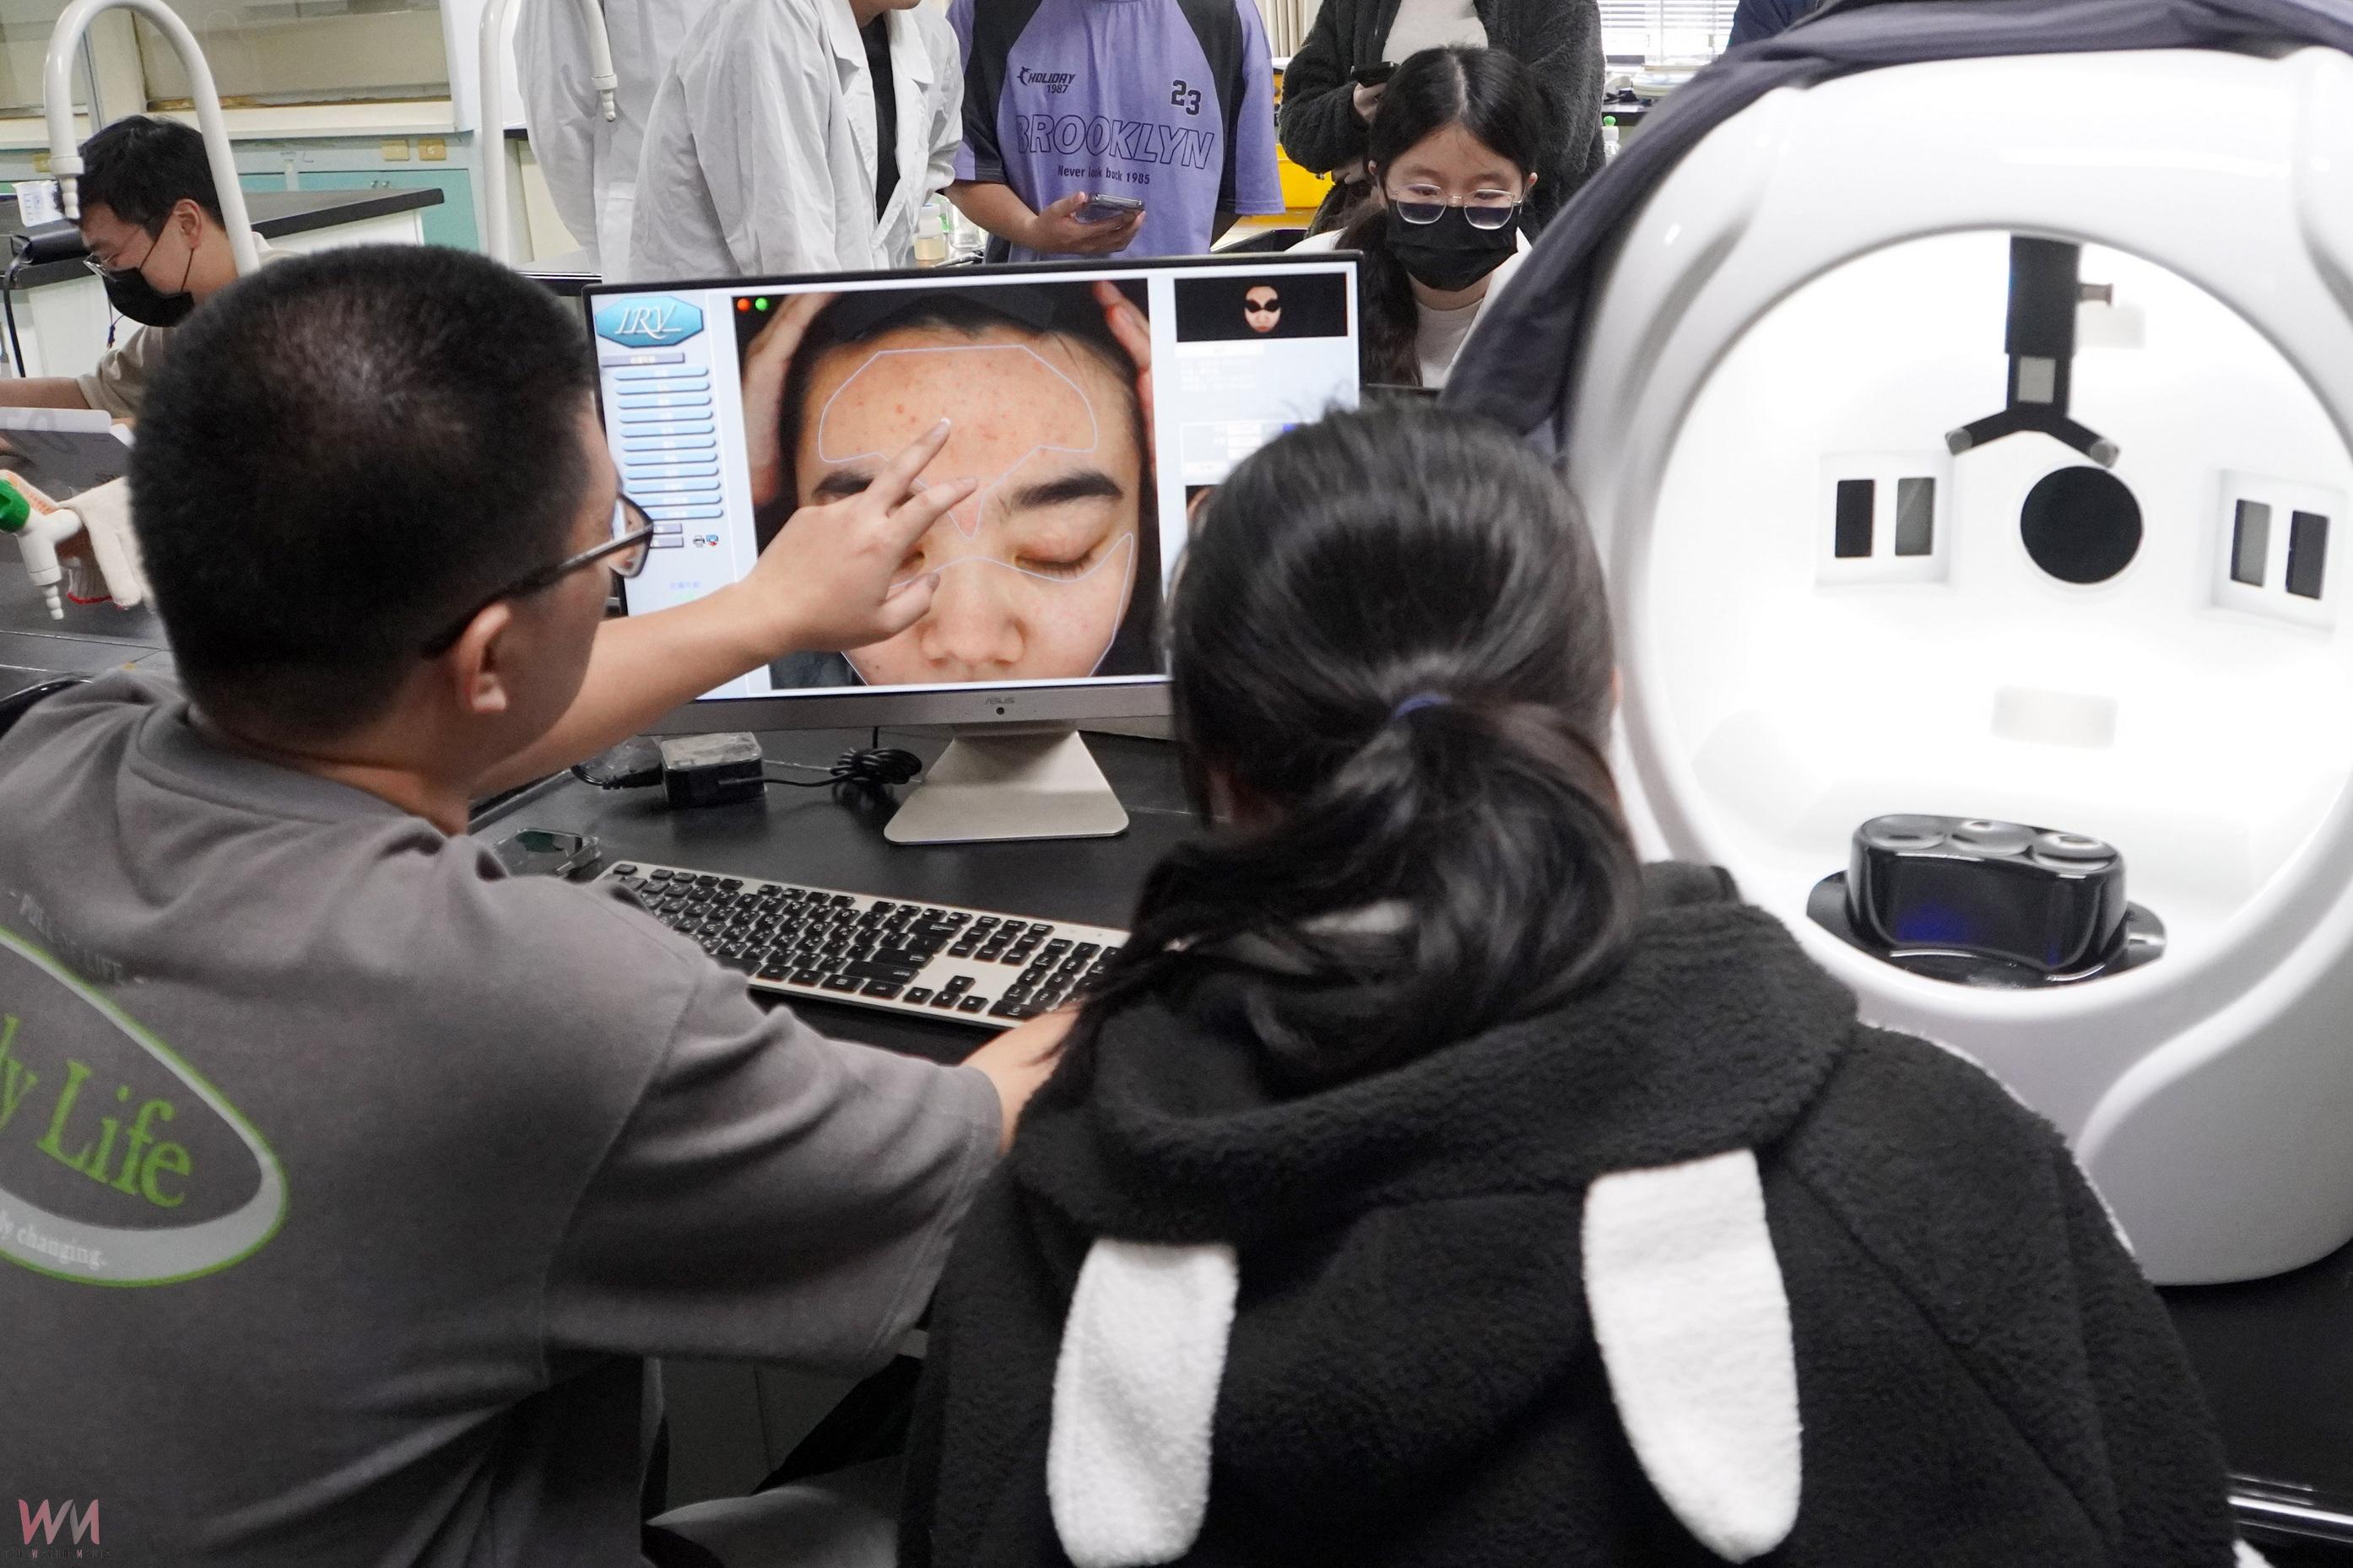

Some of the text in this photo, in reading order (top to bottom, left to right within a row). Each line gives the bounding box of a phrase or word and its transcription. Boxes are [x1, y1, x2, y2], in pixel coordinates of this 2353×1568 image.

[1027, 73, 1076, 84] HOLIDAY
[1047, 84, 1068, 94] 1987
[1171, 78, 1202, 116] 23
[1015, 114, 1215, 170] BROOKLYN
[1057, 165, 1085, 177] Never
[1126, 172, 1150, 185] 1985
[36, 1059, 192, 1208] Life
